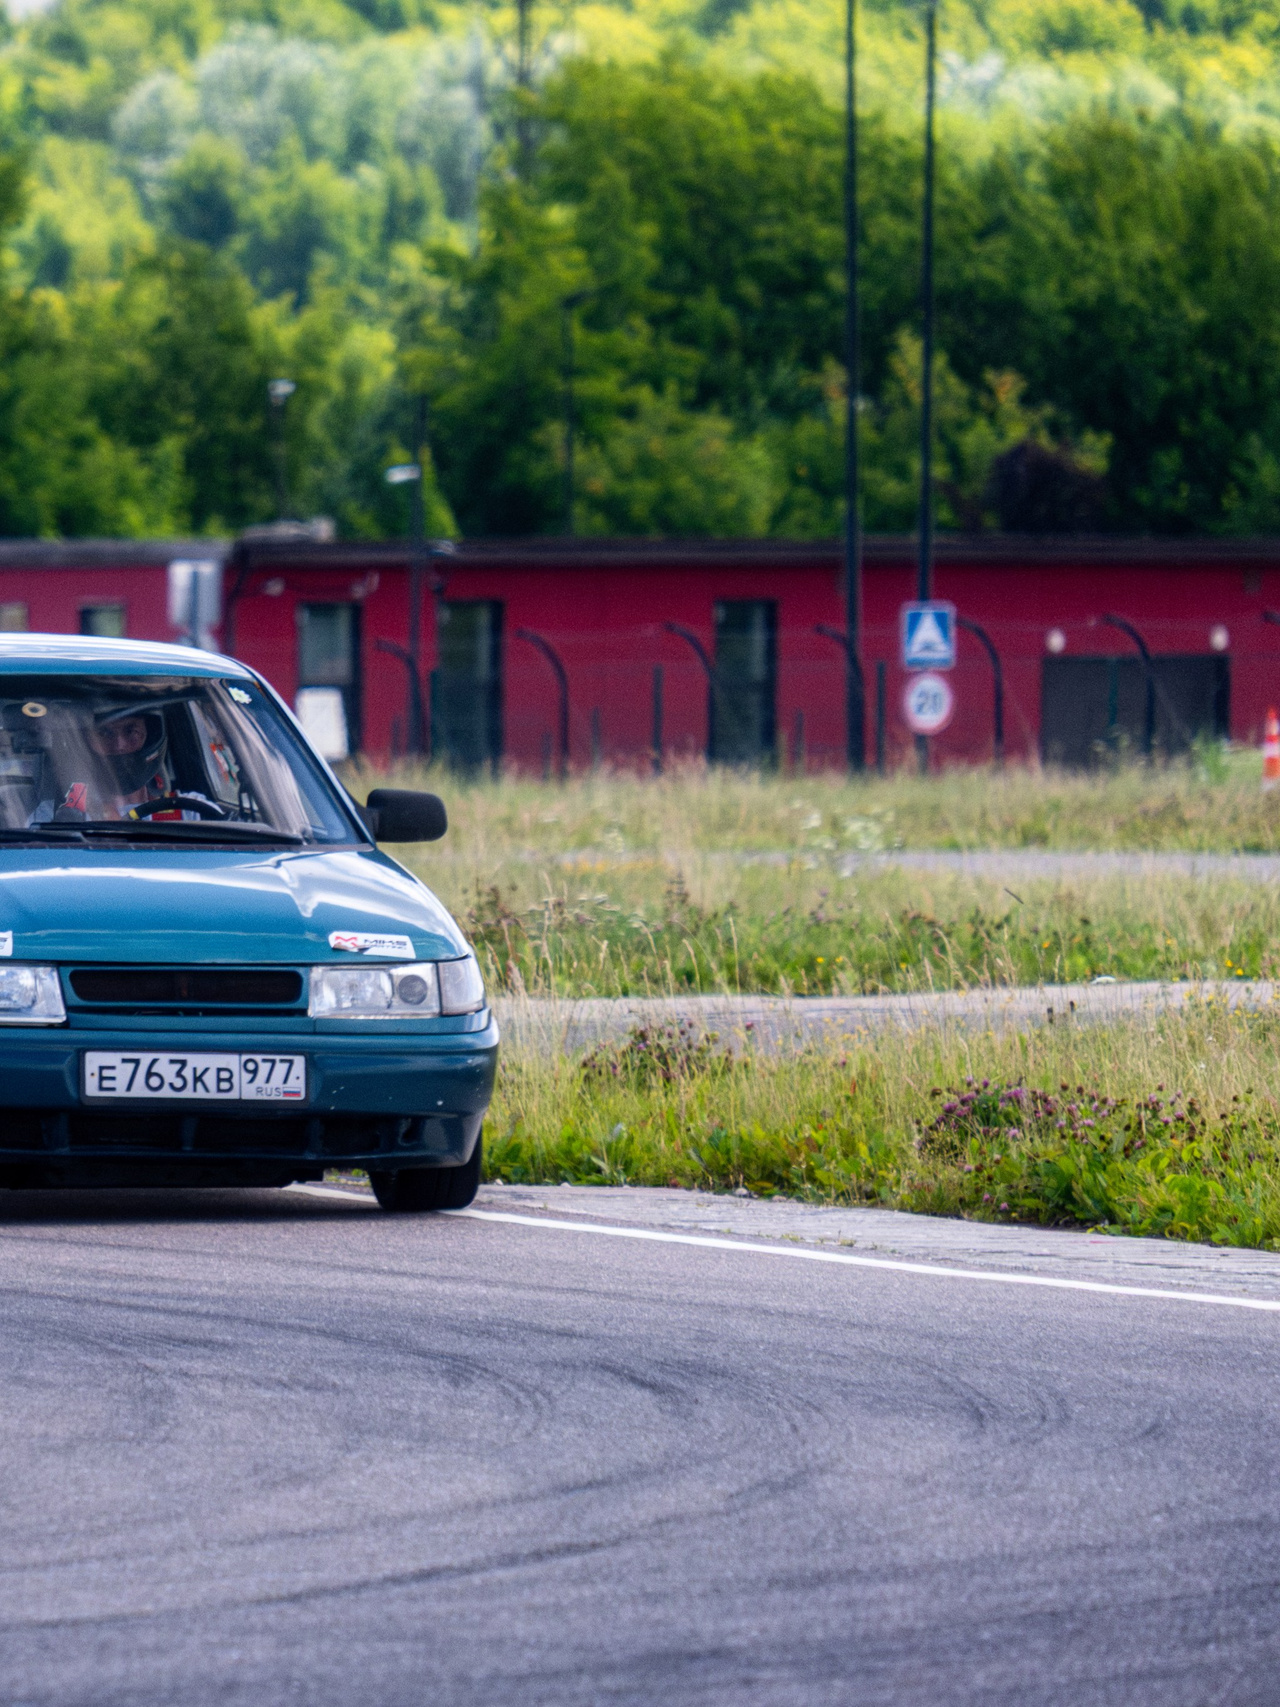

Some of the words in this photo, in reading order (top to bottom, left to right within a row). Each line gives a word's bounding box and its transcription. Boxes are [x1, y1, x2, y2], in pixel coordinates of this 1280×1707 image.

[97, 1057, 235, 1094] Е763КВ
[242, 1057, 295, 1085] 977
[255, 1087, 282, 1097] RUS
